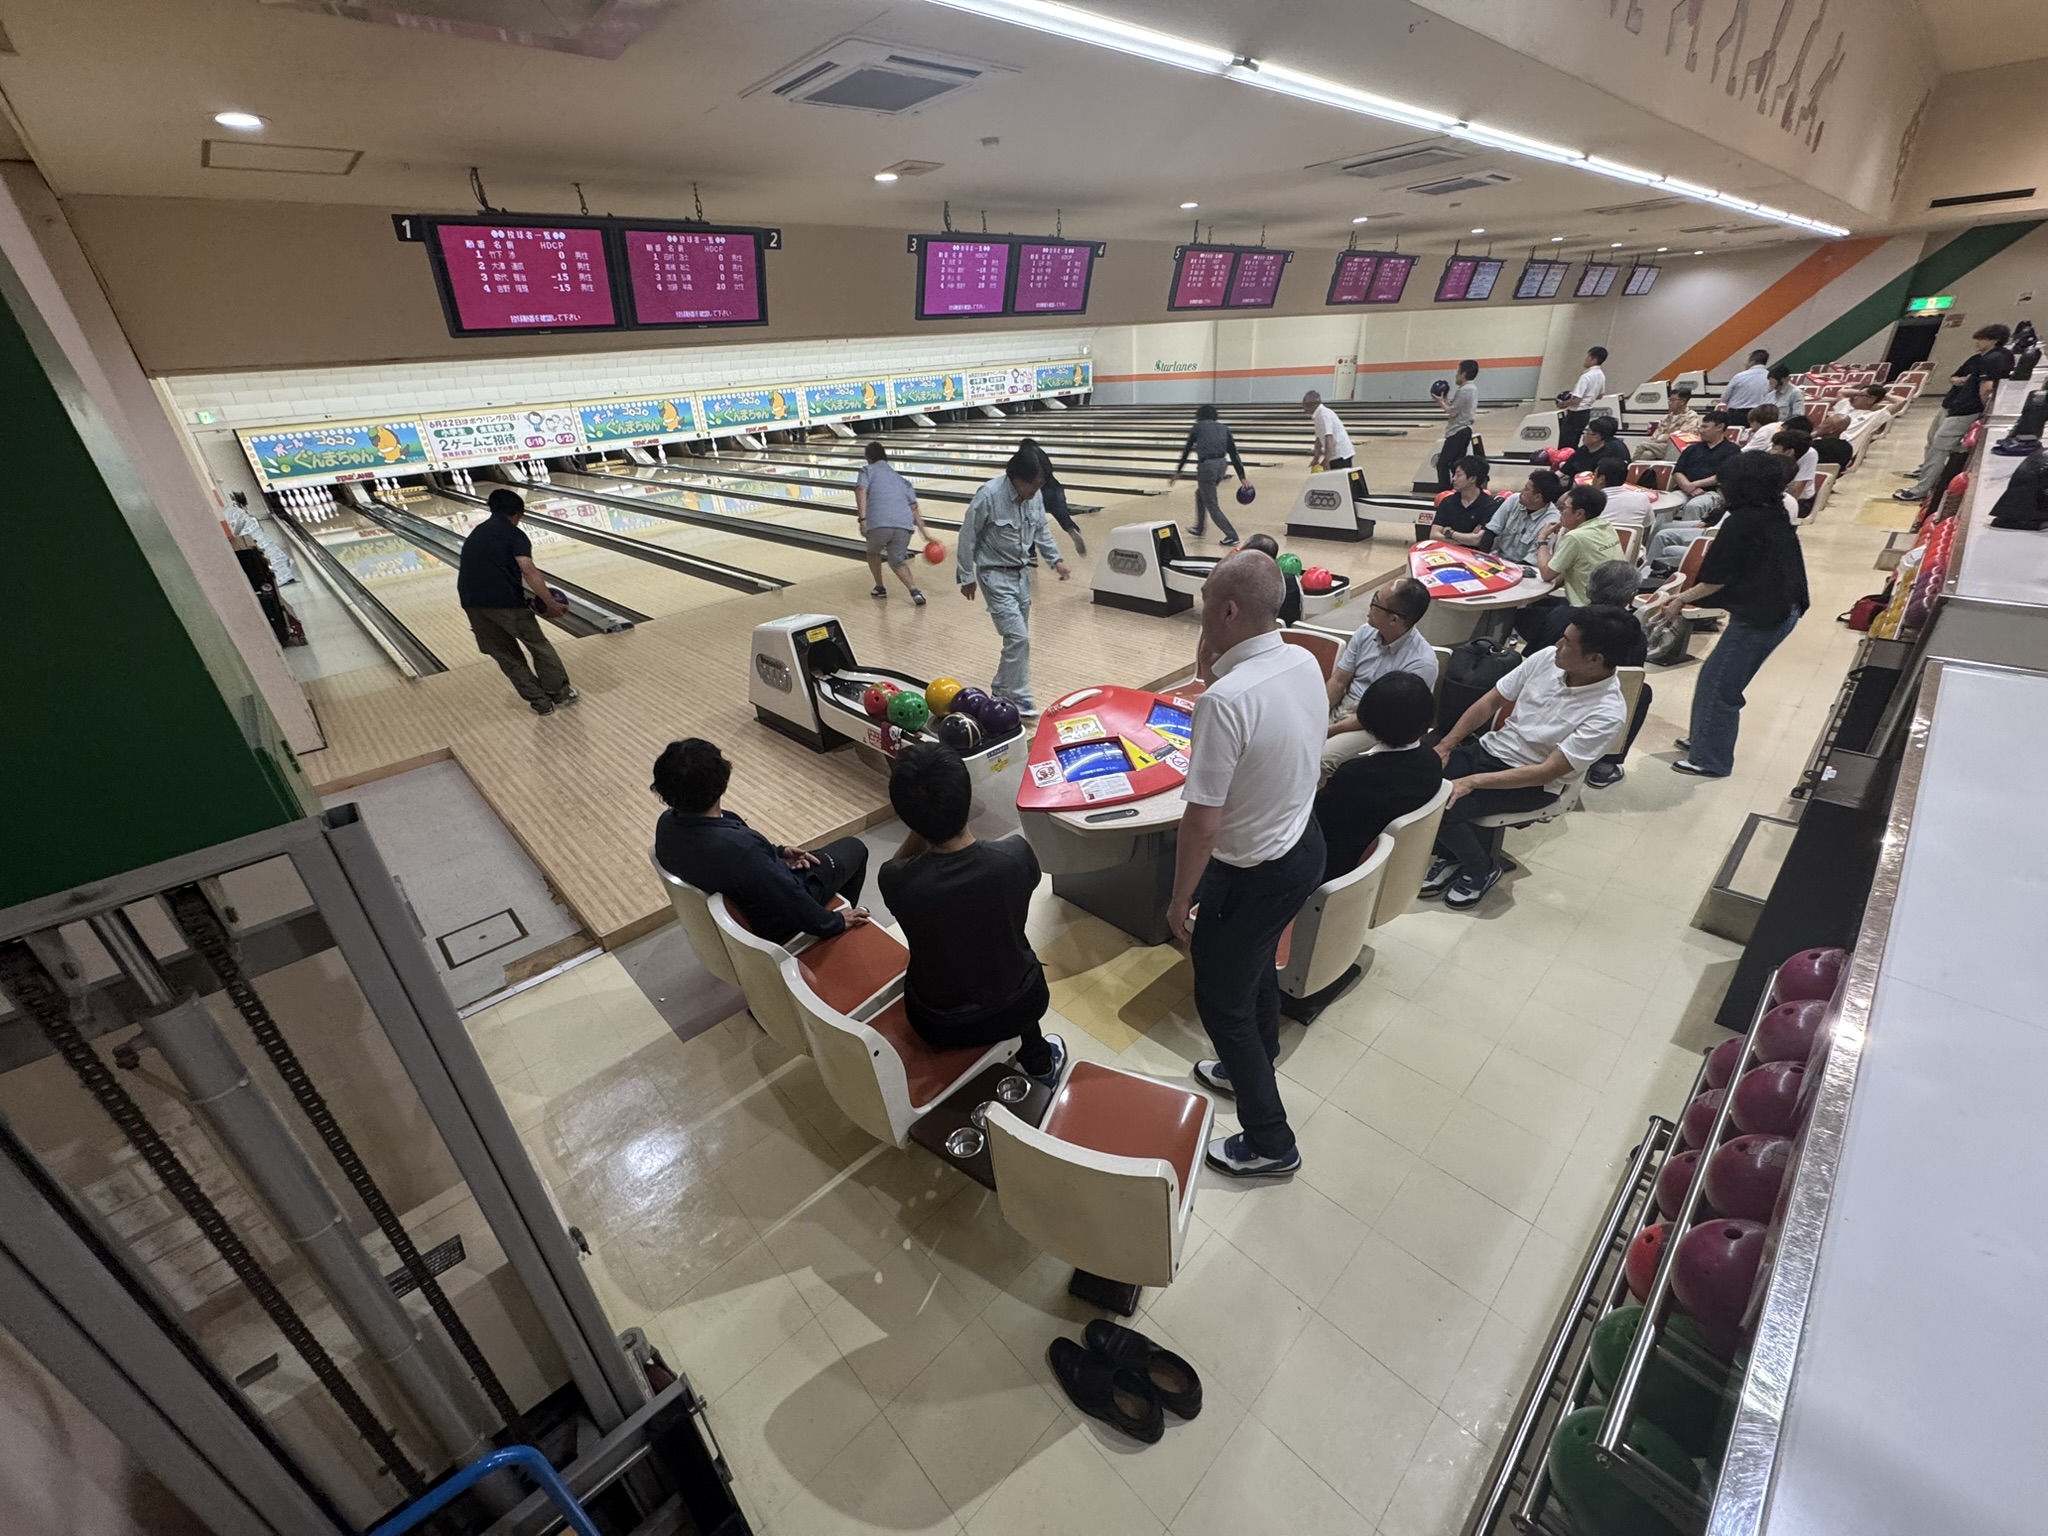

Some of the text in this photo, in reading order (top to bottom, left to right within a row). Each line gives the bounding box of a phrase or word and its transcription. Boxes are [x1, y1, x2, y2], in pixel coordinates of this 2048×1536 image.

[401, 219, 412, 239] 1
[540, 241, 564, 250] HDCP
[769, 232, 778, 247] 2
[910, 238, 918, 251] 3
[476, 250, 483, 259] 1
[558, 251, 565, 260] 0
[704, 245, 724, 253] HDCP
[1098, 244, 1105, 256] 4
[1175, 247, 1181, 259] 5
[653, 253, 659, 261] 1
[718, 254, 724, 262] 0
[478, 262, 486, 270] 2
[560, 262, 567, 271] 0
[654, 263, 660, 271] 2
[719, 264, 725, 272] 0
[481, 273, 488, 282] 3
[551, 273, 570, 282] -15
[655, 273, 661, 281] 3
[720, 273, 725, 281] 0
[483, 284, 491, 293] 4
[553, 284, 571, 293] -15
[657, 283, 663, 291] 4
[716, 283, 726, 291] 20
[1154, 359, 1198, 373] Starlanes
[724, 407, 770, 422] ぐんまちゃん
[606, 419, 660, 435] ぐんまちゃん
[315, 433, 356, 447] コロコロ
[439, 433, 516, 452] 2ゲームご招待
[294, 447, 375, 470] ぐんまちゃん
